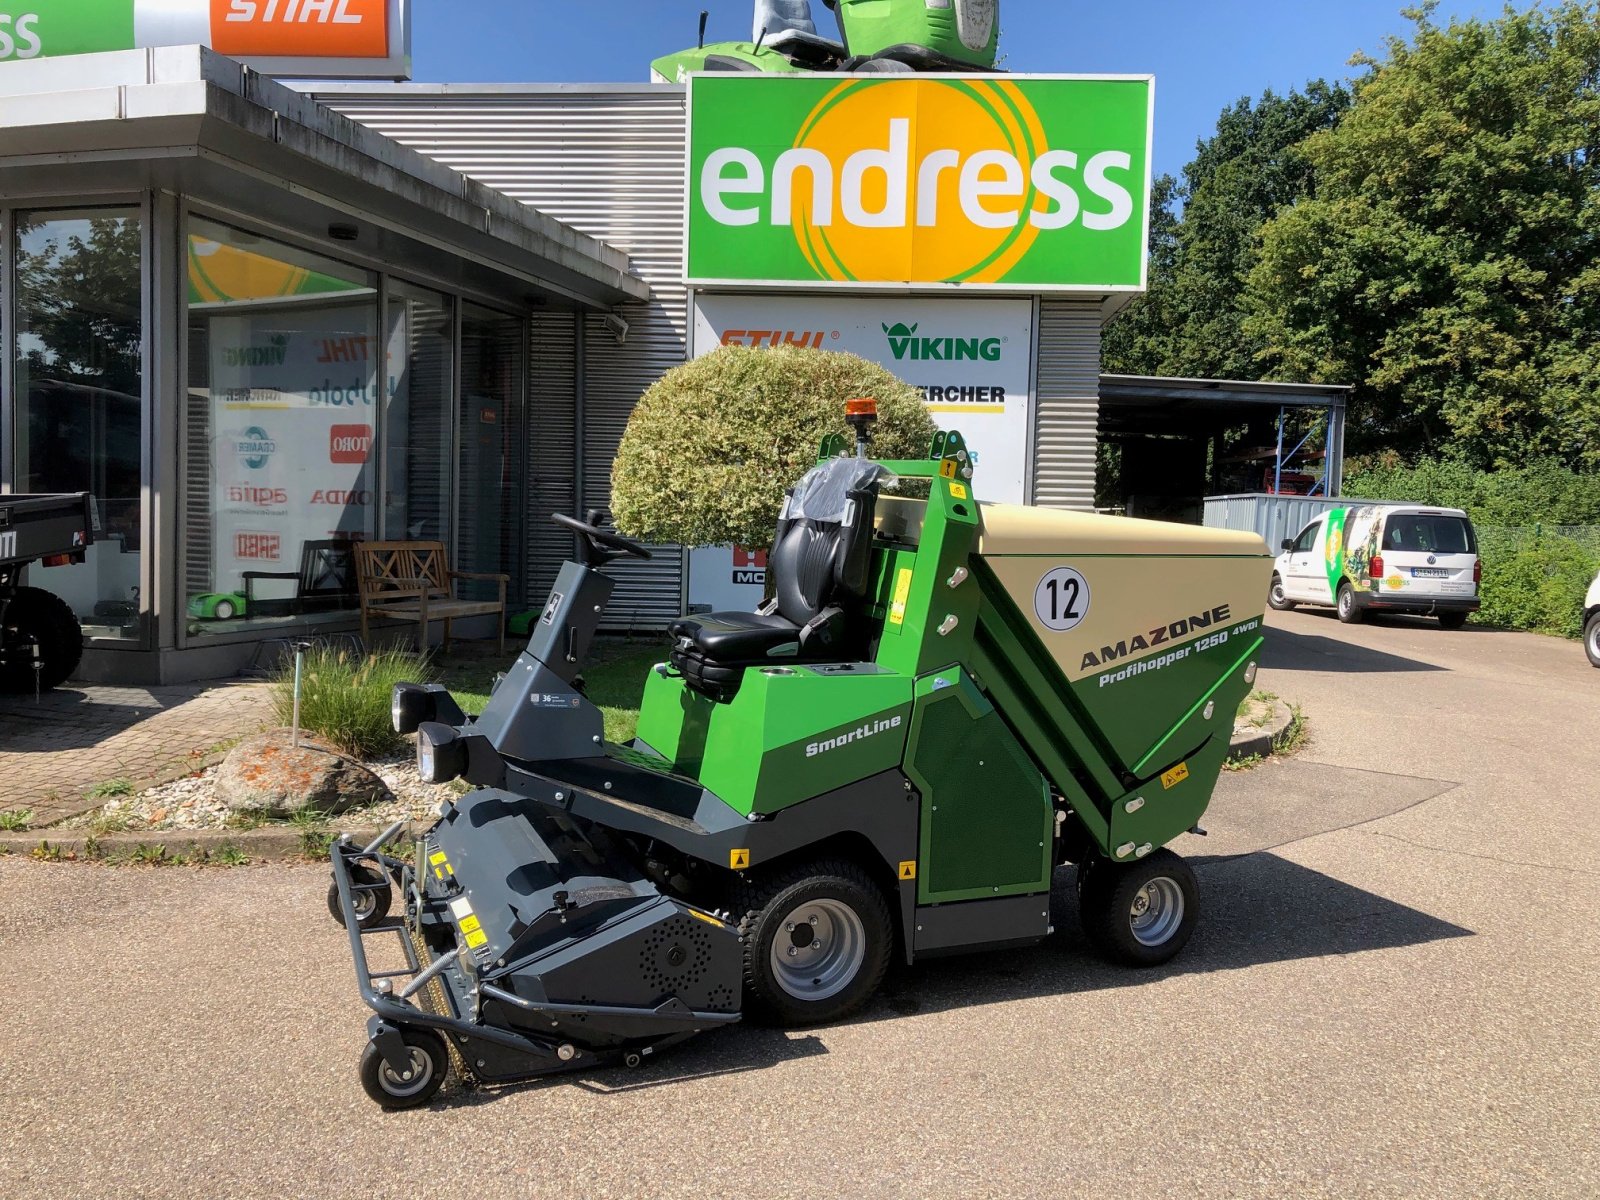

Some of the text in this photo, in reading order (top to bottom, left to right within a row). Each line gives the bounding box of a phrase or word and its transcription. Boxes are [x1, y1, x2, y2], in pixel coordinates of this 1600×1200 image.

[225, 0, 363, 24] STIHL
[700, 118, 1133, 230] endress
[888, 337, 1001, 361] VIKING
[917, 385, 1006, 402] RCHER
[0, 531, 17, 558] TI
[1046, 577, 1080, 620] 12
[1080, 604, 1231, 671] AMAZONE
[1099, 646, 1191, 688] Profihopper
[1194, 631, 1228, 655] 1250
[542, 694, 552, 702] 36
[805, 715, 901, 758] SmartLine
